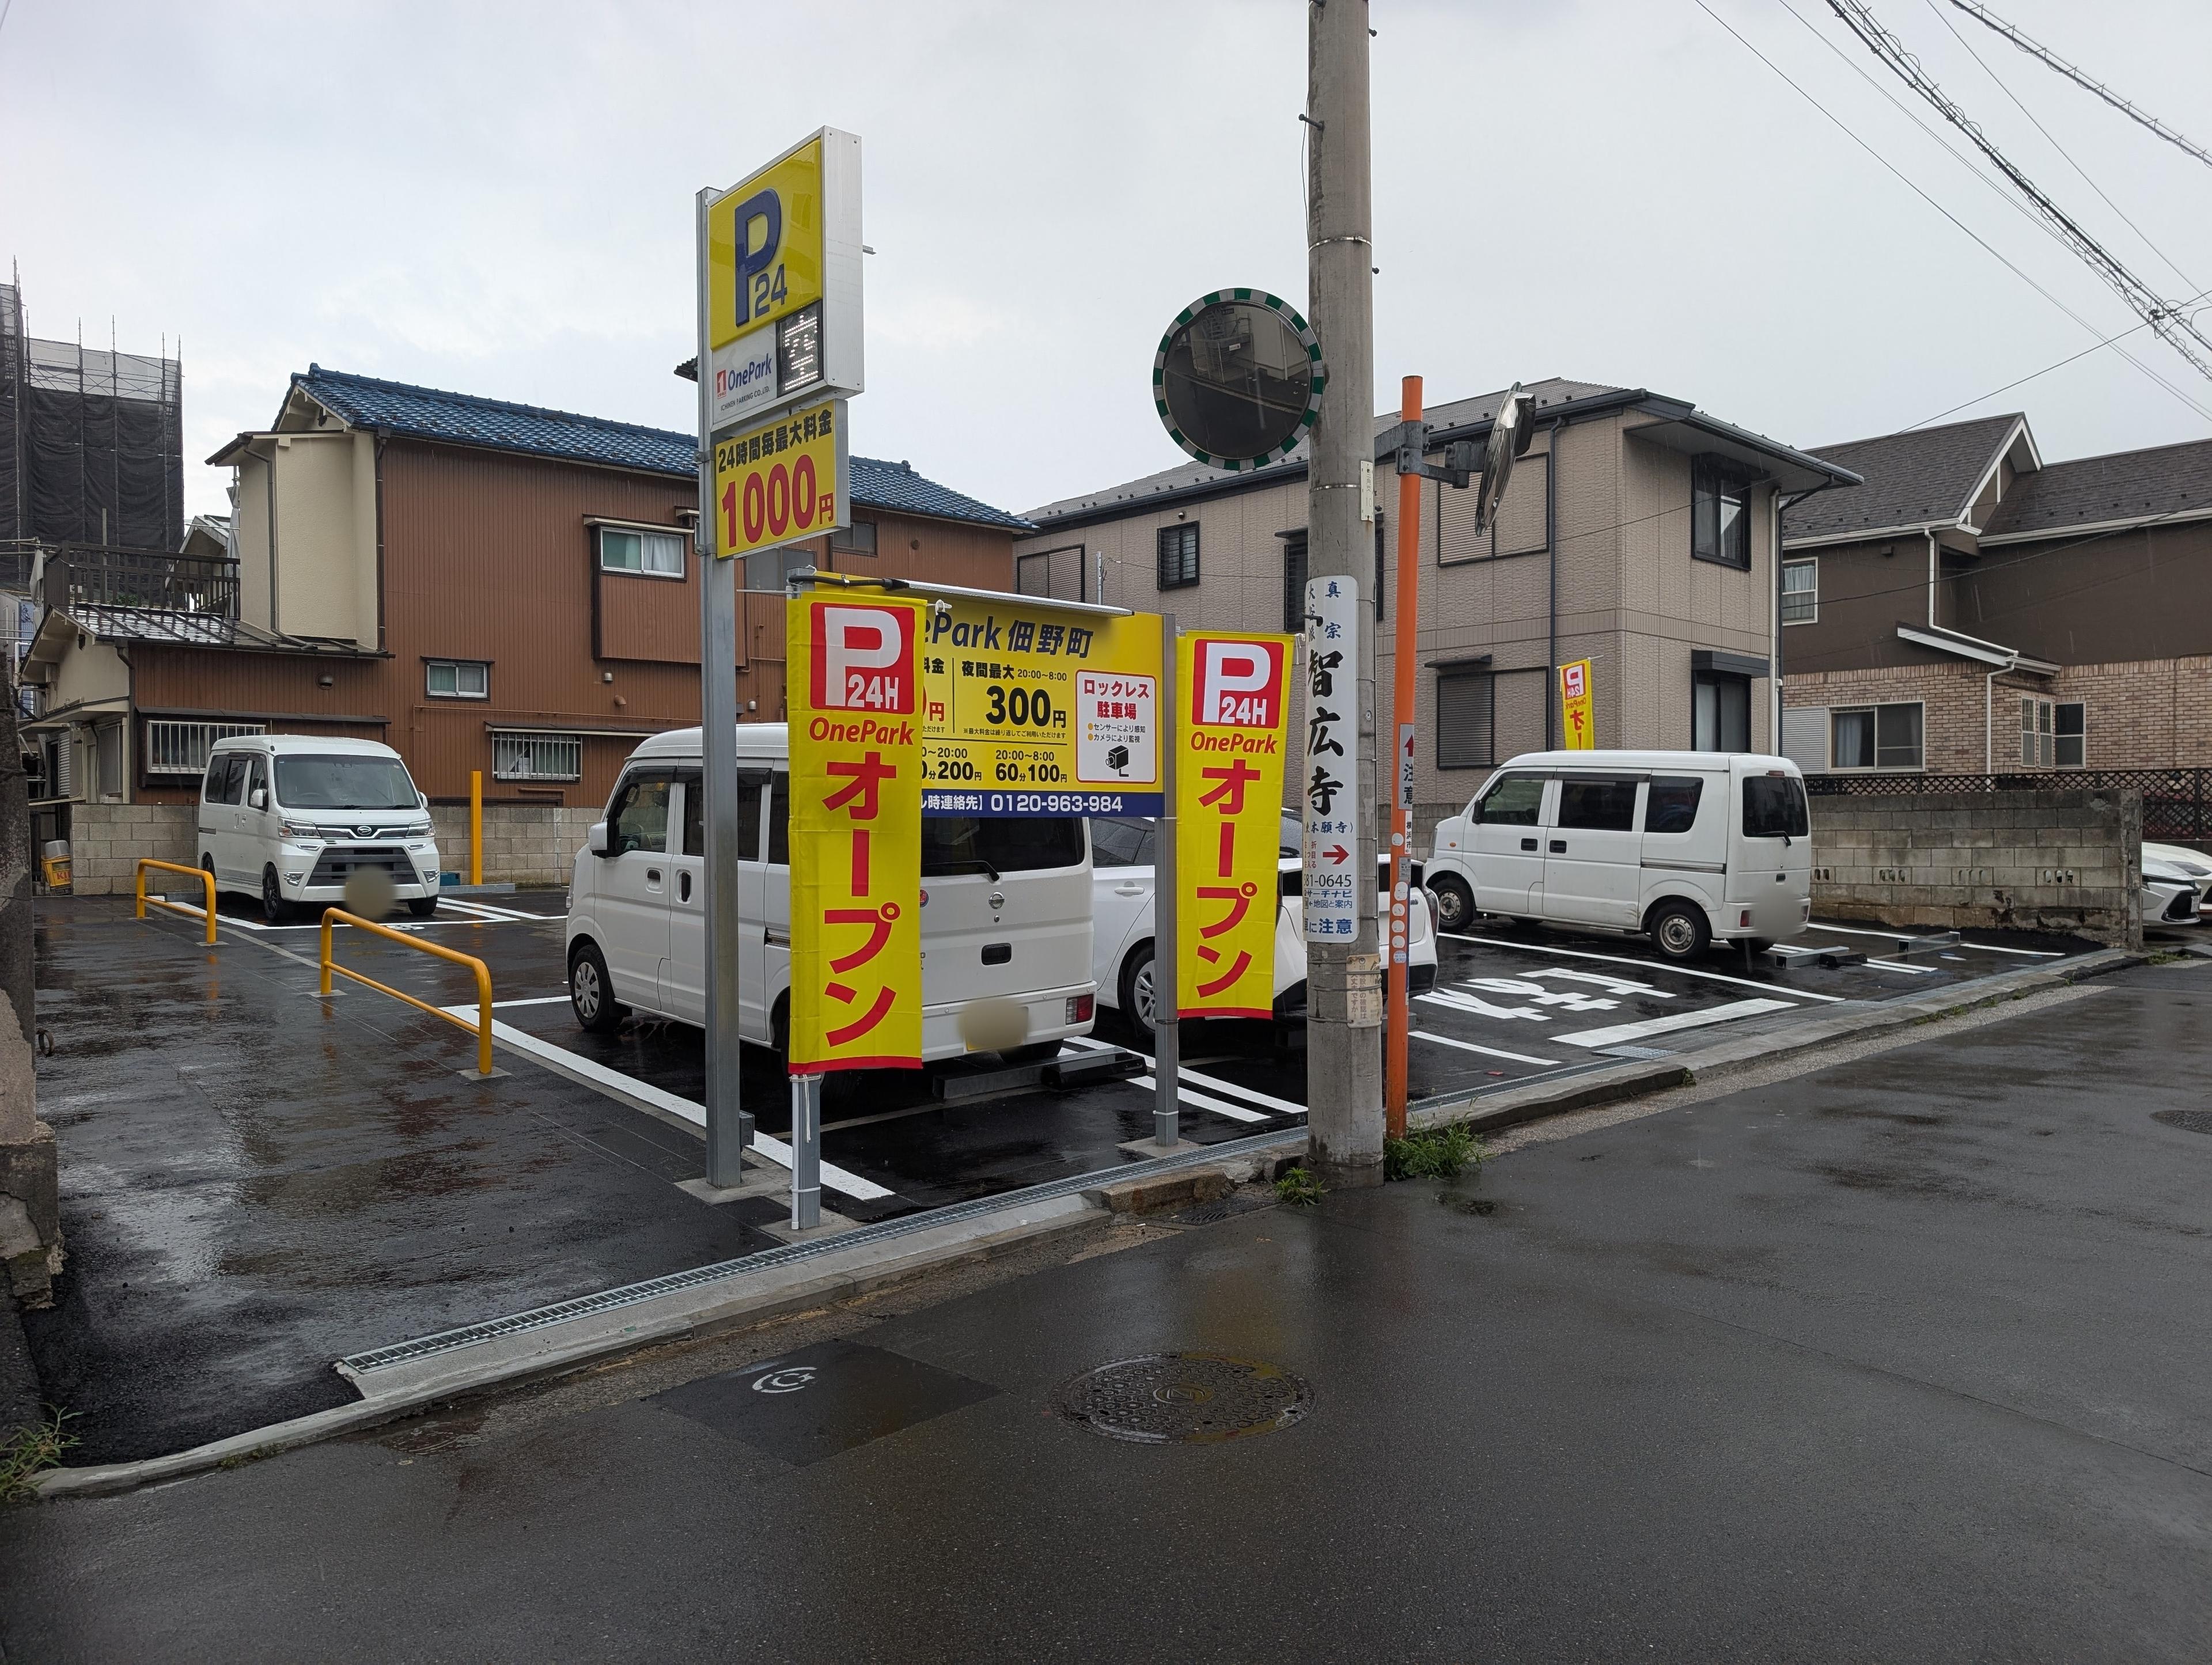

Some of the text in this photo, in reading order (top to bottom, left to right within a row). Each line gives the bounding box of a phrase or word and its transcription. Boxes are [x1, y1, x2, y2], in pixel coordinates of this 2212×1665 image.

[735, 187, 782, 328] P
[755, 263, 788, 318] 24
[728, 352, 772, 391] OnePark
[785, 314, 818, 392] 空
[737, 393, 753, 405] PARKING
[718, 409, 832, 473] 24時間毎最大料金
[722, 454, 834, 548] 1000円
[1325, 581, 1342, 639] 真宗
[824, 606, 902, 710] P 24H
[1005, 620, 1094, 659] 佃野町
[961, 661, 1015, 680] 夜間最大
[1084, 680, 1150, 699] ロックレス
[1203, 642, 1271, 725] P 24H
[923, 686, 945, 722] 円
[985, 685, 1067, 729] 300円
[1097, 701, 1137, 720] 駐車場
[809, 717, 916, 746] OnePark
[1093, 723, 1146, 733] センサーにより感知
[1093, 733, 1141, 743] カメラにより監視
[1191, 731, 1278, 754] OnePark
[1306, 650, 1344, 816] 智広寺
[995, 763, 1067, 783] 60分100円
[991, 795, 1123, 813] 0120-963-984
[1196, 758, 1261, 998] オープン
[821, 751, 900, 1048] オープン
[1313, 899, 1353, 909] 地図と案内
